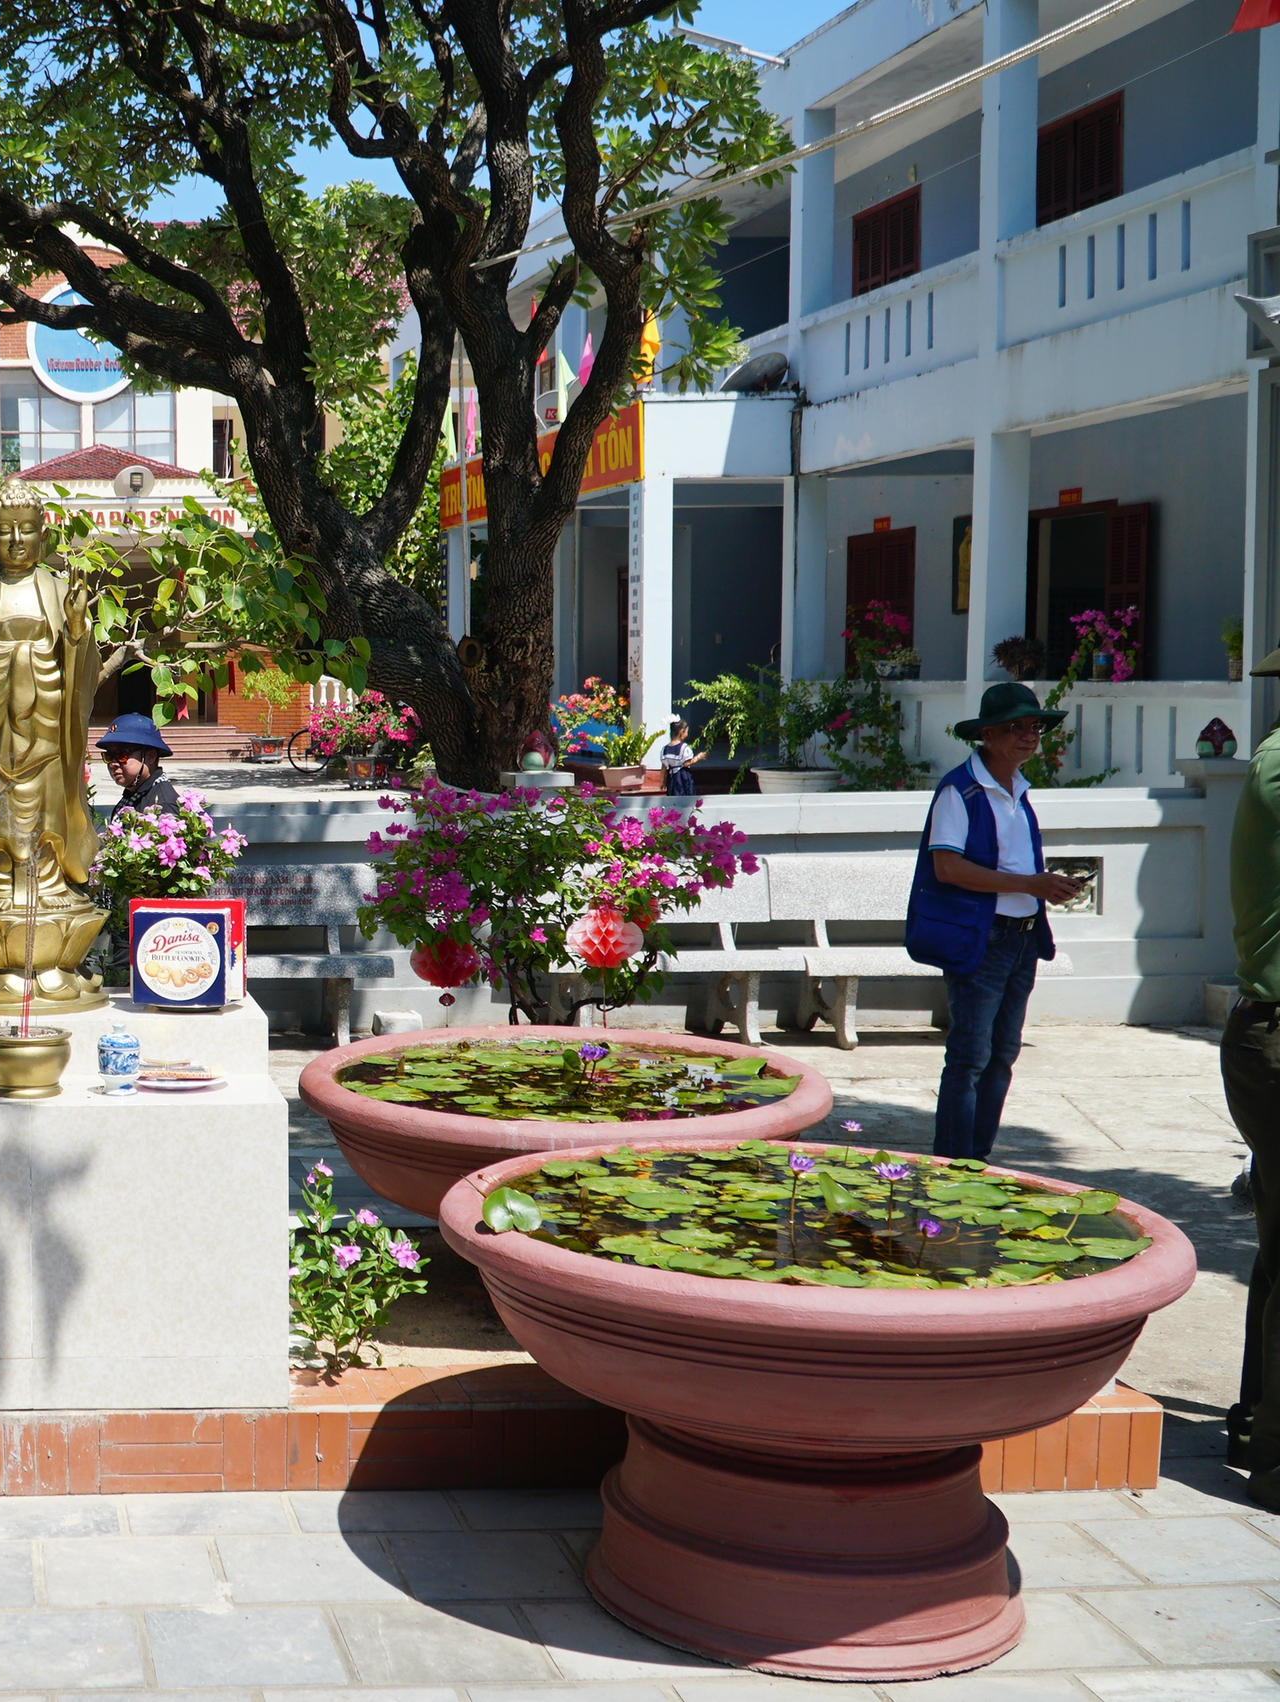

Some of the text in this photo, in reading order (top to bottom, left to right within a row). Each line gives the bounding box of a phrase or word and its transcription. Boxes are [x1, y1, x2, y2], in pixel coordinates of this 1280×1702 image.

[46, 357, 123, 372] Vietnam Rubber Grou
[597, 416, 633, 474] TỒN
[149, 930, 201, 953] Danisa
[176, 954, 206, 962] COOKIES
